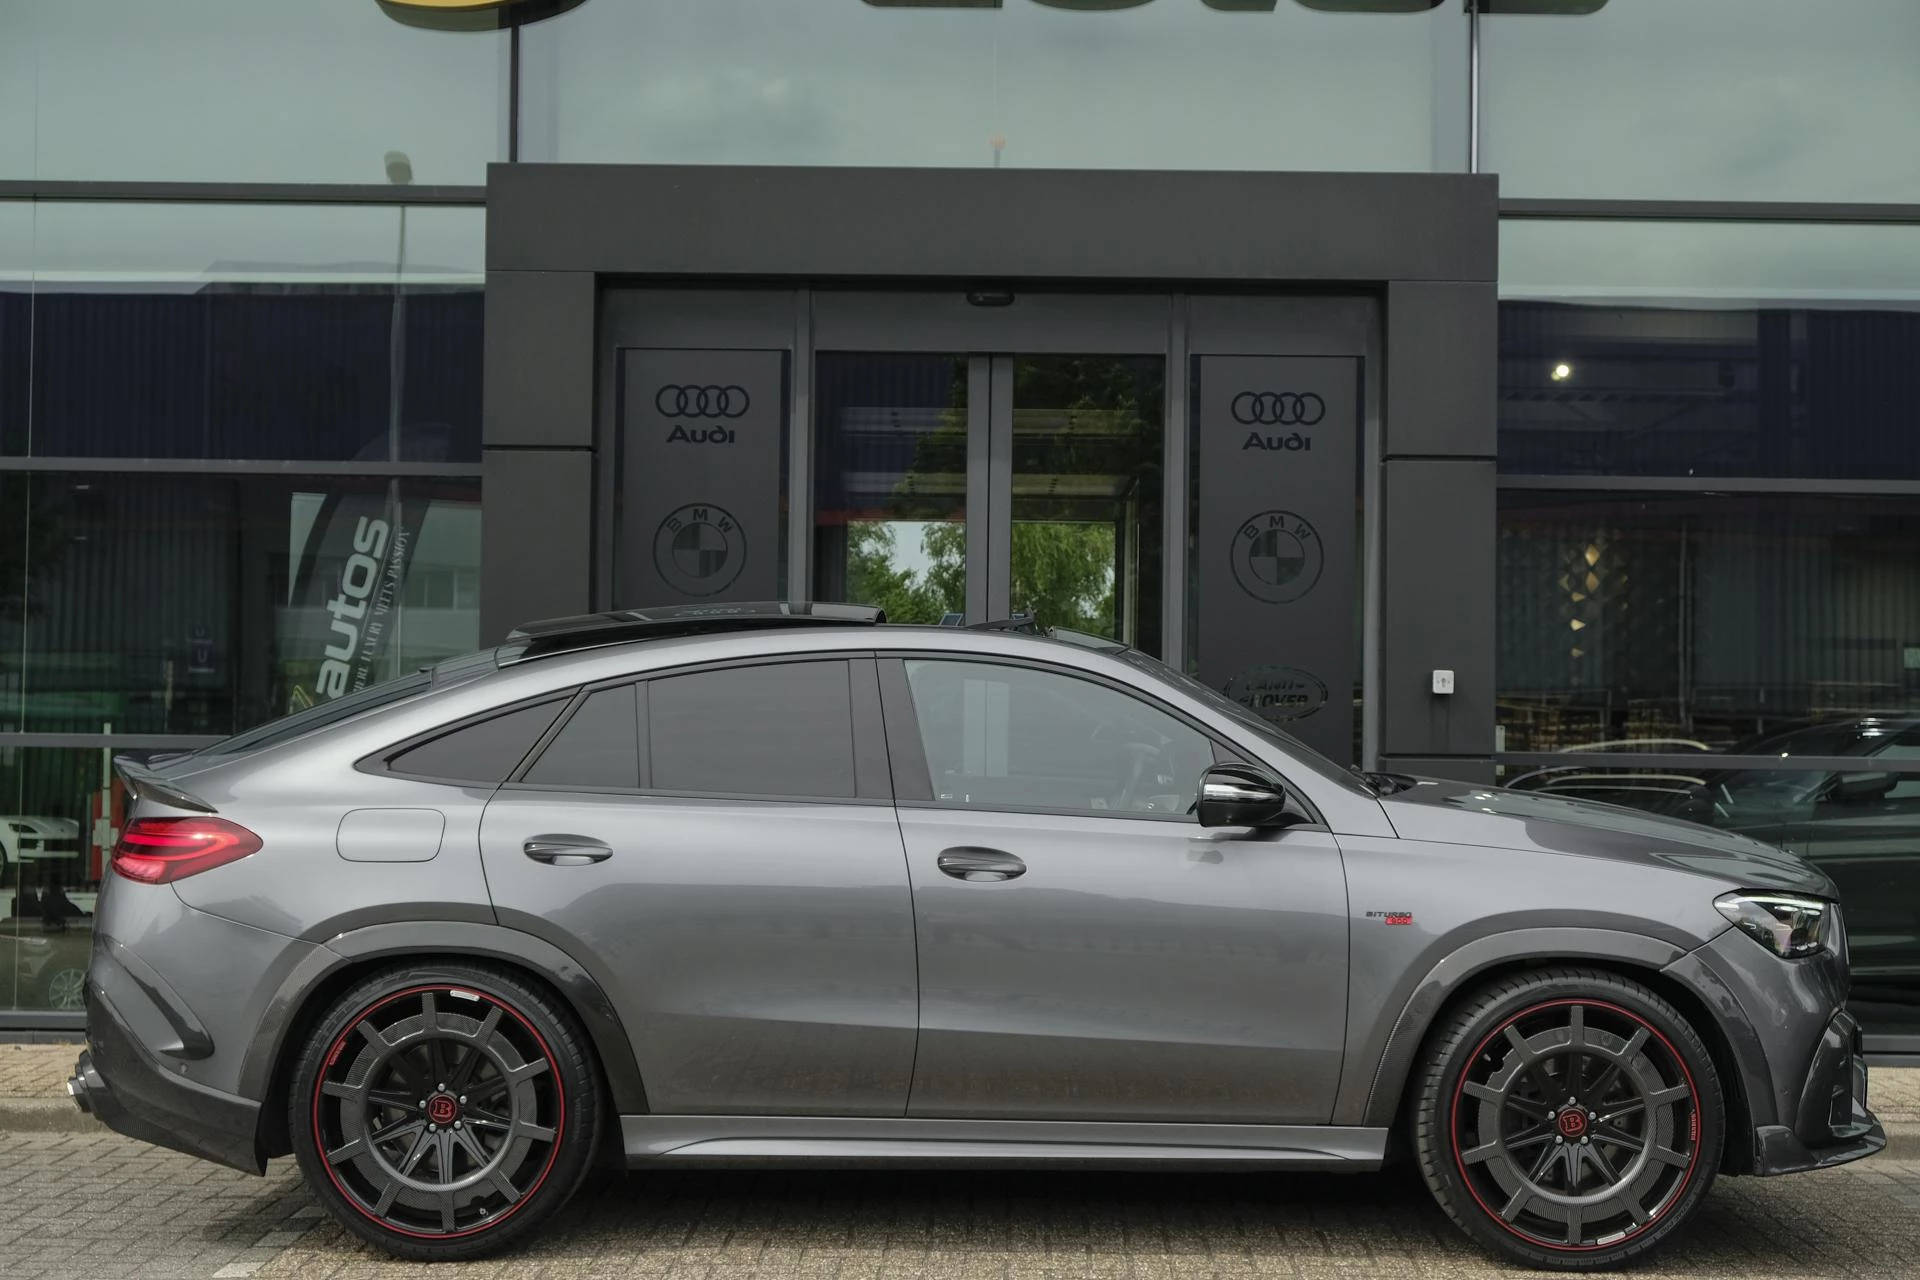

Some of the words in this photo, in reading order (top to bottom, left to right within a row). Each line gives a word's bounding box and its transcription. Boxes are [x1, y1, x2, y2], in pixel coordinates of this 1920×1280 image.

[666, 424, 735, 443] Audi
[1242, 432, 1311, 451] Audi
[666, 508, 733, 533] BMW
[1243, 515, 1311, 540] BMW
[316, 515, 390, 699] autos
[375, 580, 396, 618] MEETS
